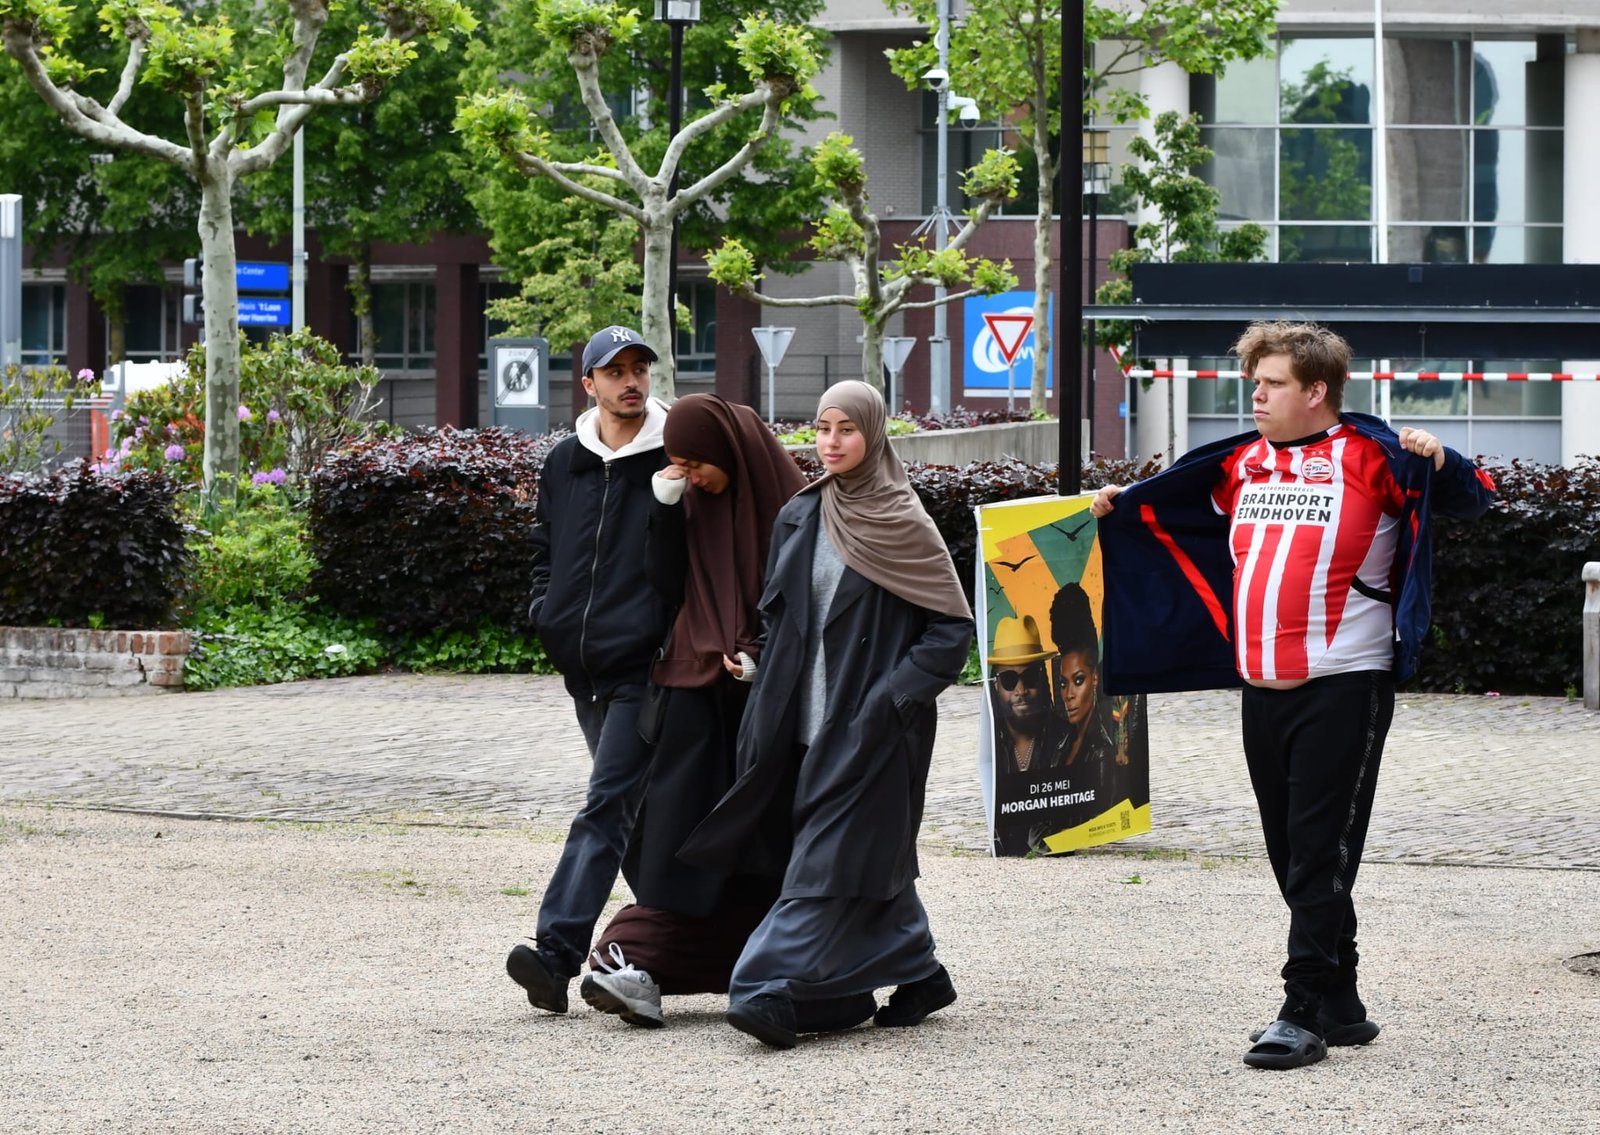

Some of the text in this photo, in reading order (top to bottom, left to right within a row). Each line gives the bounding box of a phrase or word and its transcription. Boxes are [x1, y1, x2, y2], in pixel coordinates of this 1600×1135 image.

[243, 267, 265, 275] Center
[251, 314, 278, 322] Heerlen
[1242, 494, 1334, 507] BRAINPORT
[1237, 508, 1331, 522] EINDHOVEN
[1030, 779, 1071, 795] DI 26 MEI
[1001, 790, 1095, 814] MORGAN HERITAGE
